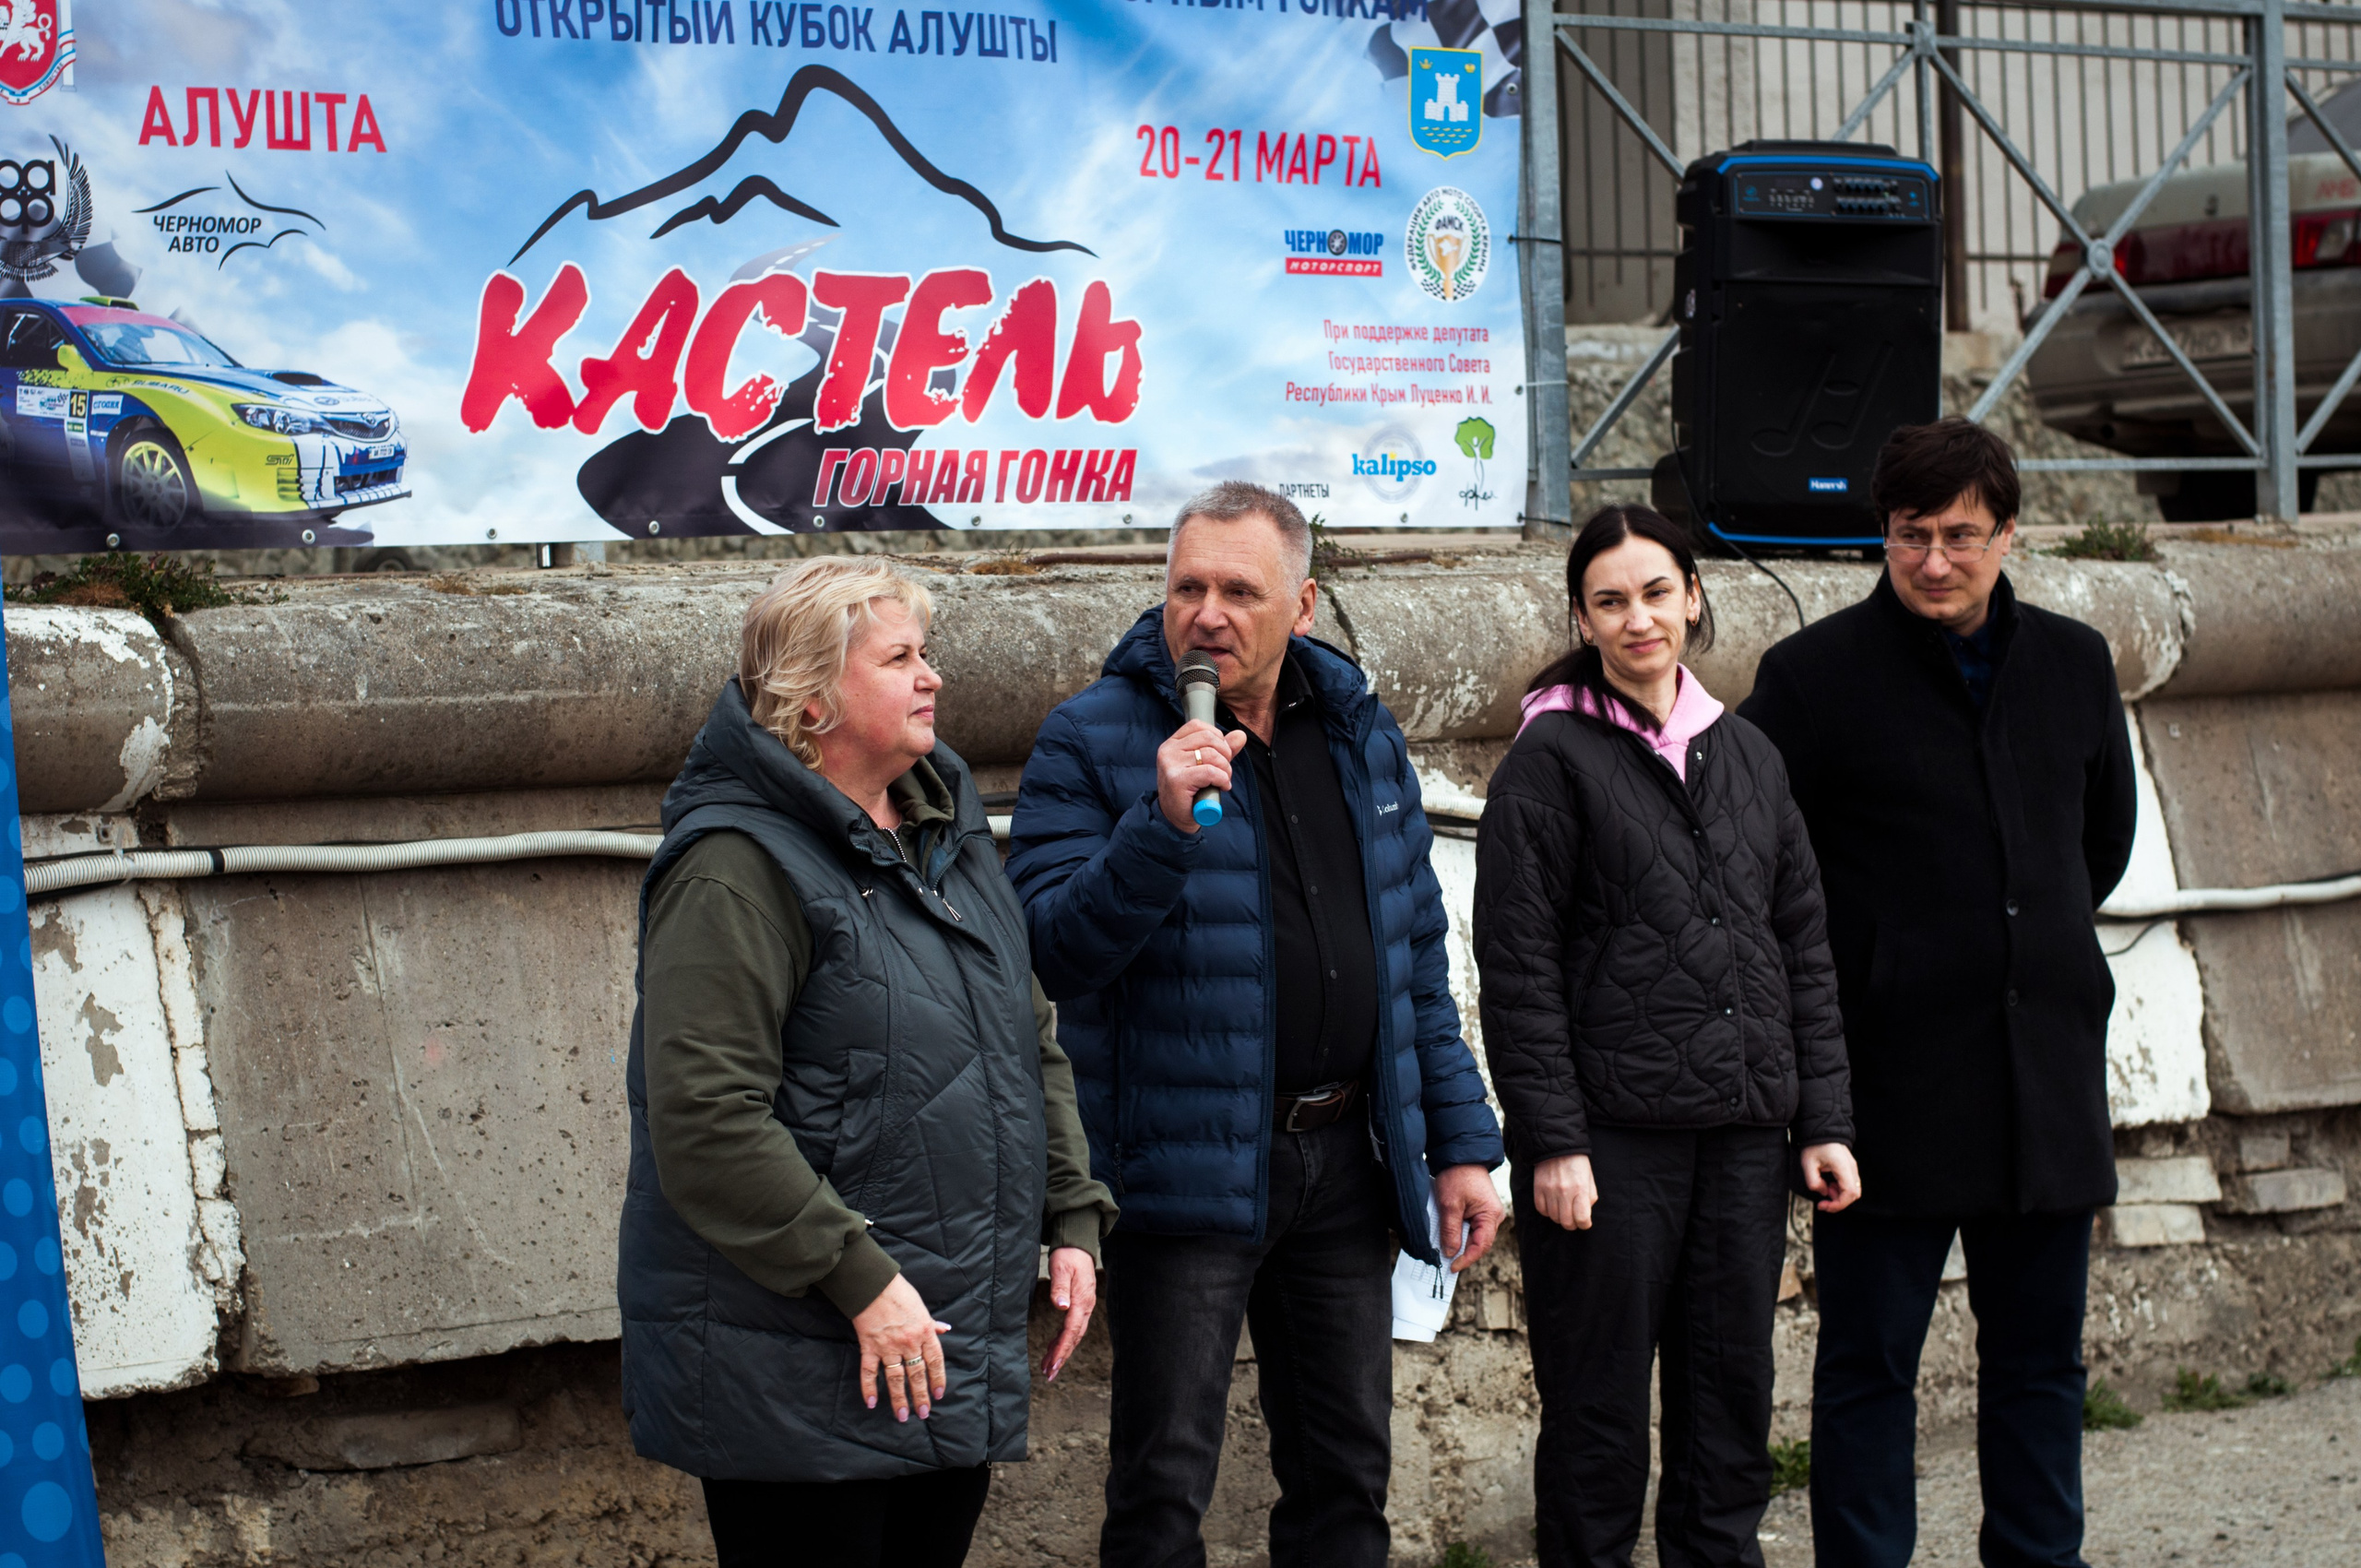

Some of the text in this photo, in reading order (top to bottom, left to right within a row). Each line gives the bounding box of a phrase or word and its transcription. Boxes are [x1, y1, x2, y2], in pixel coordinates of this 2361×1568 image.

[750, 1, 876, 53] КУБОК
[888, 7, 1058, 63] АЛУШТЫ
[138, 85, 386, 152] АЛУШТА
[1136, 125, 1382, 187] 20-21 МАРТА
[153, 215, 262, 234] ЧЕРНОМОР
[1407, 208, 1423, 270] ФЕДЕРАЦИЯ
[1423, 189, 1441, 207] АВТО
[1442, 188, 1464, 200] МОТО
[1477, 234, 1489, 273] КРЫМА
[1435, 215, 1465, 232] ФАМСК
[168, 236, 219, 253] АВТО
[1289, 261, 1380, 274] МОТОРСПОРТ
[1323, 319, 1489, 347] При поддержке депутата
[460, 262, 1144, 442] КАСТЕЛЬ
[1328, 350, 1491, 375] Государственного Совета
[70, 393, 87, 417] 15
[1286, 381, 1493, 408] Республики Крым Луценко И. И.
[813, 446, 1139, 506] ГОРНАЯ ГОНКА
[1352, 452, 1437, 482] kalipso
